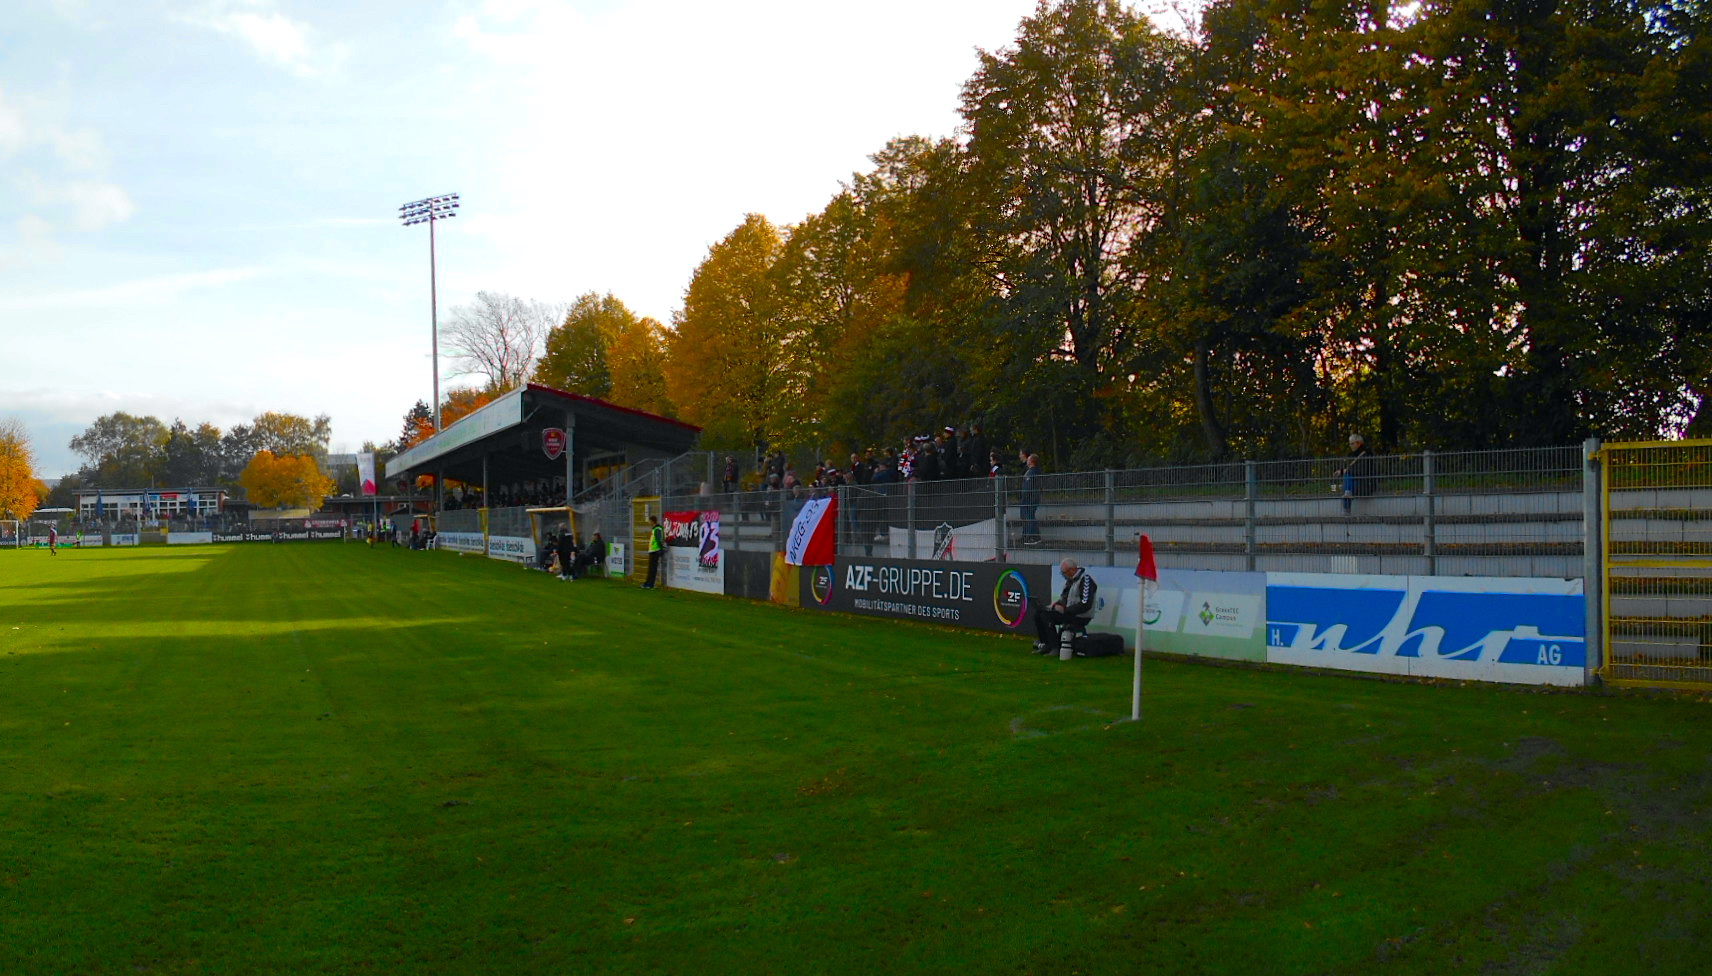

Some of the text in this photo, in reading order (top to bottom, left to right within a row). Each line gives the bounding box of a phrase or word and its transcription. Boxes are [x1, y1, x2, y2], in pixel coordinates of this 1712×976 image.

[218, 533, 243, 541] hummel
[845, 564, 974, 602] AZF-GRUPPE.DE
[854, 598, 960, 620] MOBILITÄTSPARTNER DES SPORTS
[1271, 629, 1285, 647] H.
[1537, 644, 1562, 665] AG
